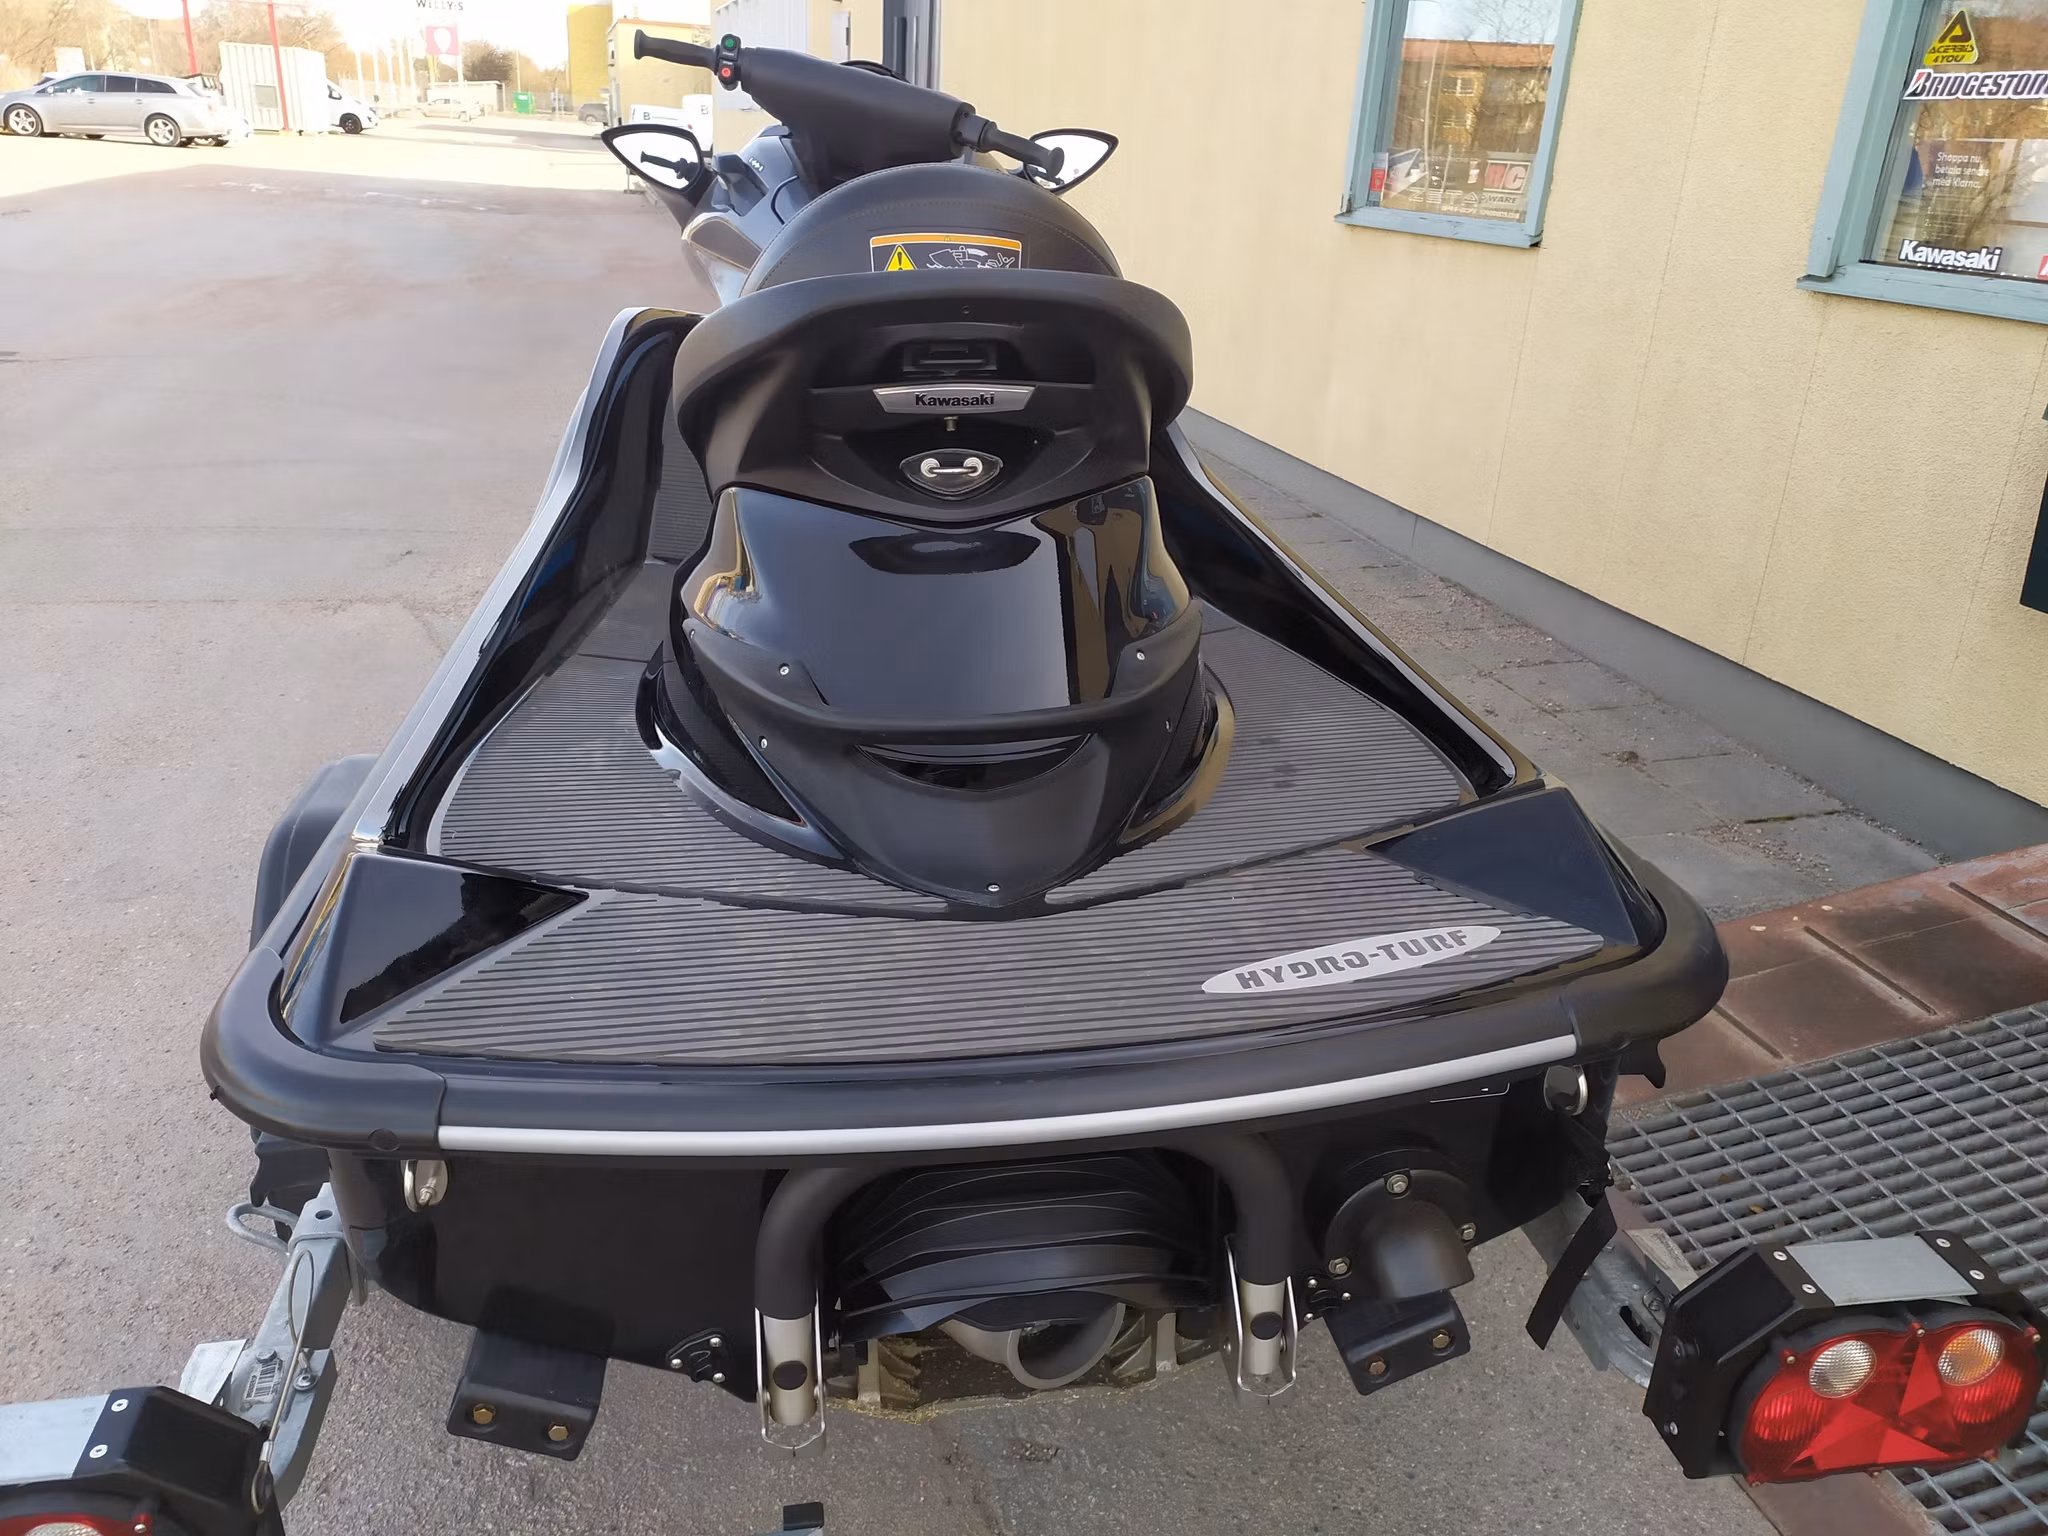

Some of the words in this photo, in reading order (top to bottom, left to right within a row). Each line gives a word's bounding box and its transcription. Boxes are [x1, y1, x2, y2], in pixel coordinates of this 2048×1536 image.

[1937, 151, 1968, 164] Shoppa
[1899, 239, 2001, 271] Kawasaki
[915, 392, 995, 407] Kawasaki
[1235, 929, 1468, 990] HYDRO-TURF
